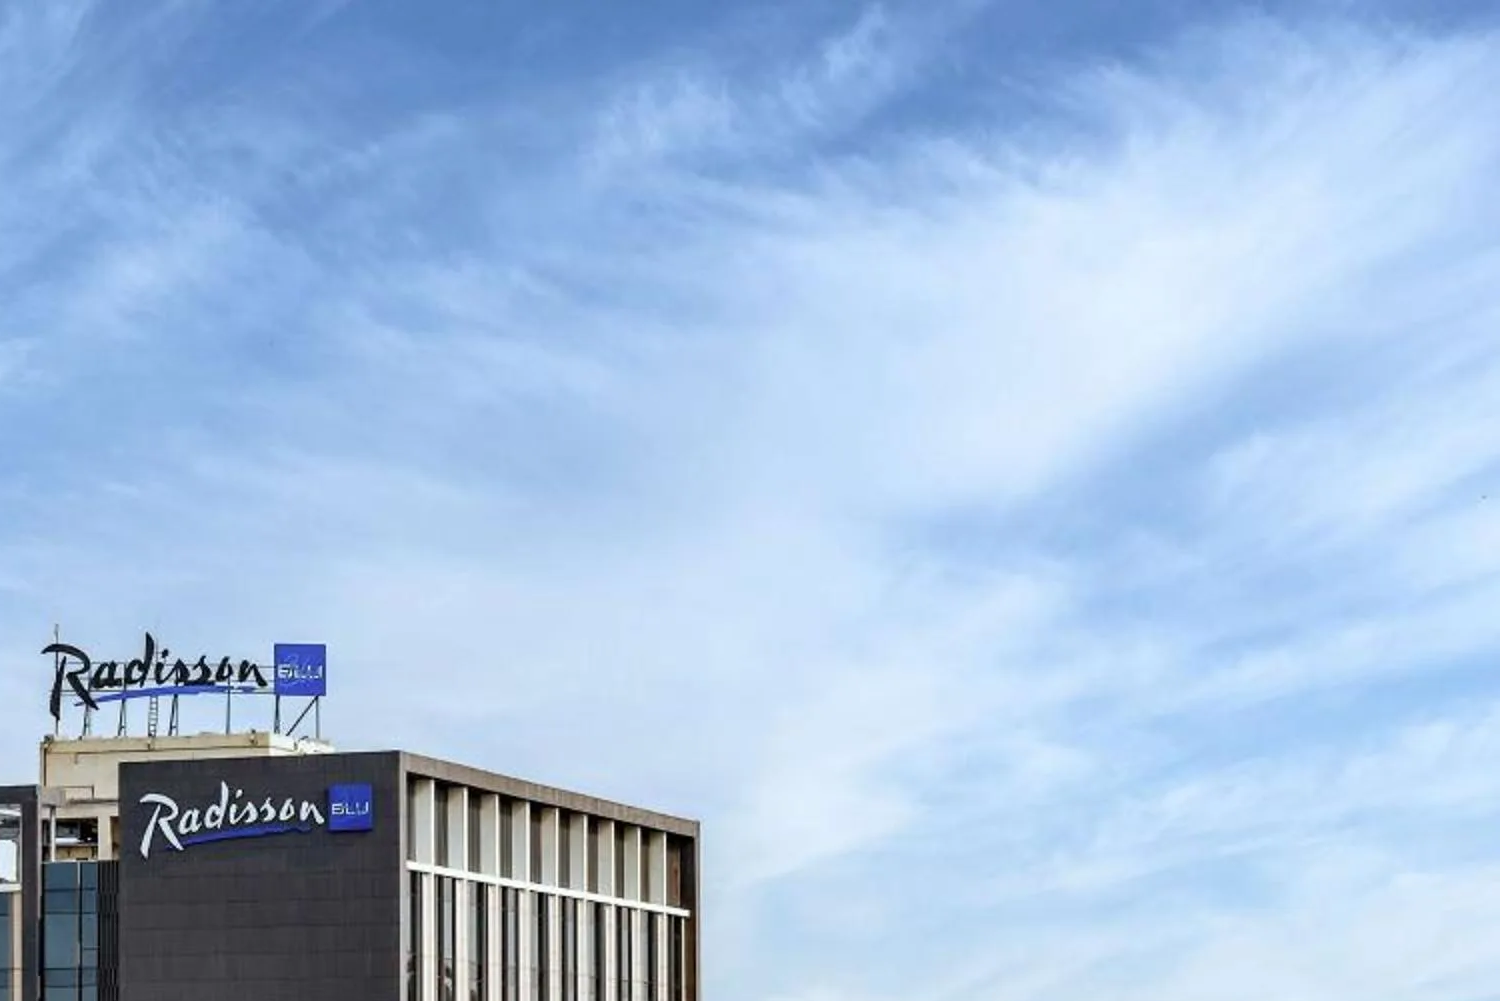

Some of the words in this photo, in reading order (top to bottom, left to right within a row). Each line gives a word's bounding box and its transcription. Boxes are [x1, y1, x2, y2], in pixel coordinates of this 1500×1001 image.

[41, 632, 267, 720] Radisson
[277, 664, 323, 679] BLU
[140, 780, 325, 858] Radisson
[331, 801, 369, 815] BLU
